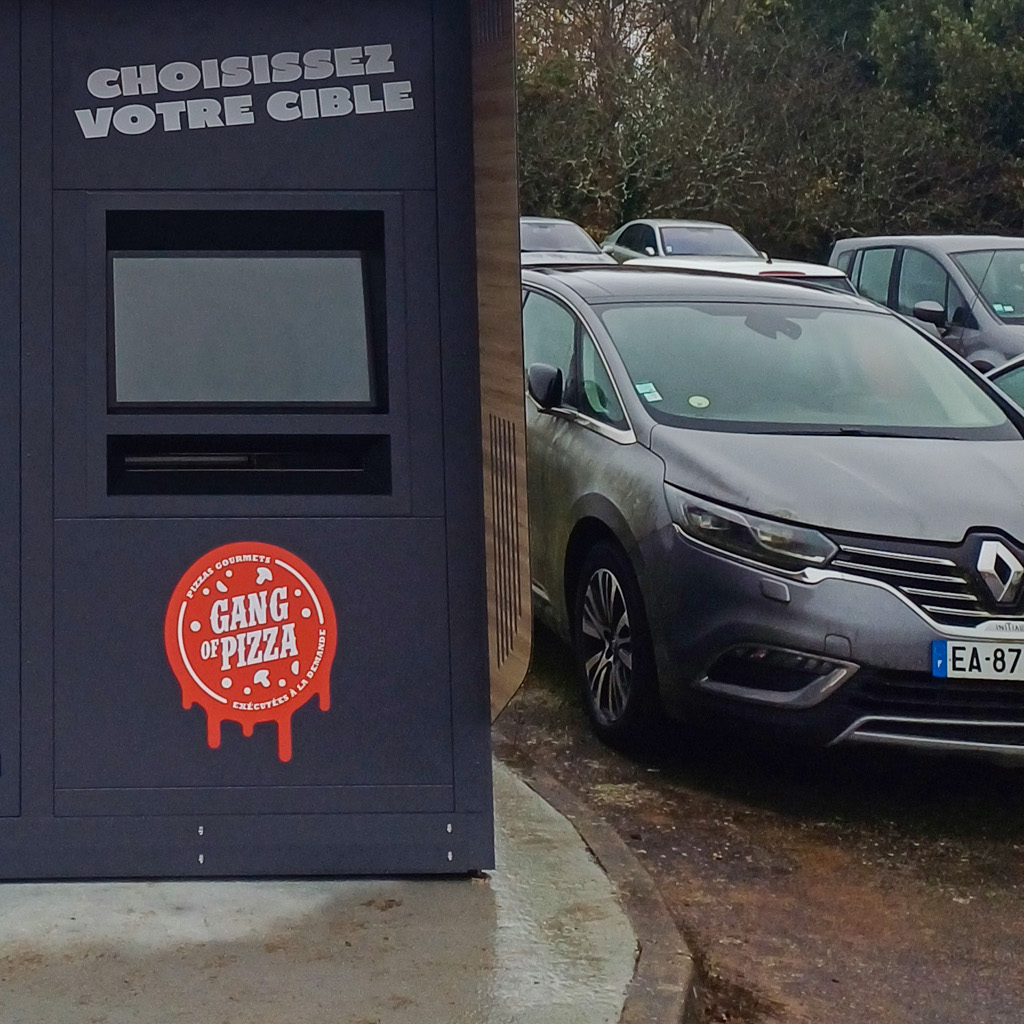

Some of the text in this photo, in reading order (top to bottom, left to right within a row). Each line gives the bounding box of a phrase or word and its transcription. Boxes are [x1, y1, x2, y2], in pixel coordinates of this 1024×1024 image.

[87, 44, 395, 99] CHOISISSEZ
[74, 81, 414, 139] VOTRE CIBLE
[186, 554, 271, 599] PIZZAS GOURMETS
[209, 586, 289, 634] GANG
[200, 622, 299, 671] OF PIZZA
[232, 629, 326, 711] EXÉCUTÉES À LA DEMANDE
[951, 646, 1022, 674] EA-87
